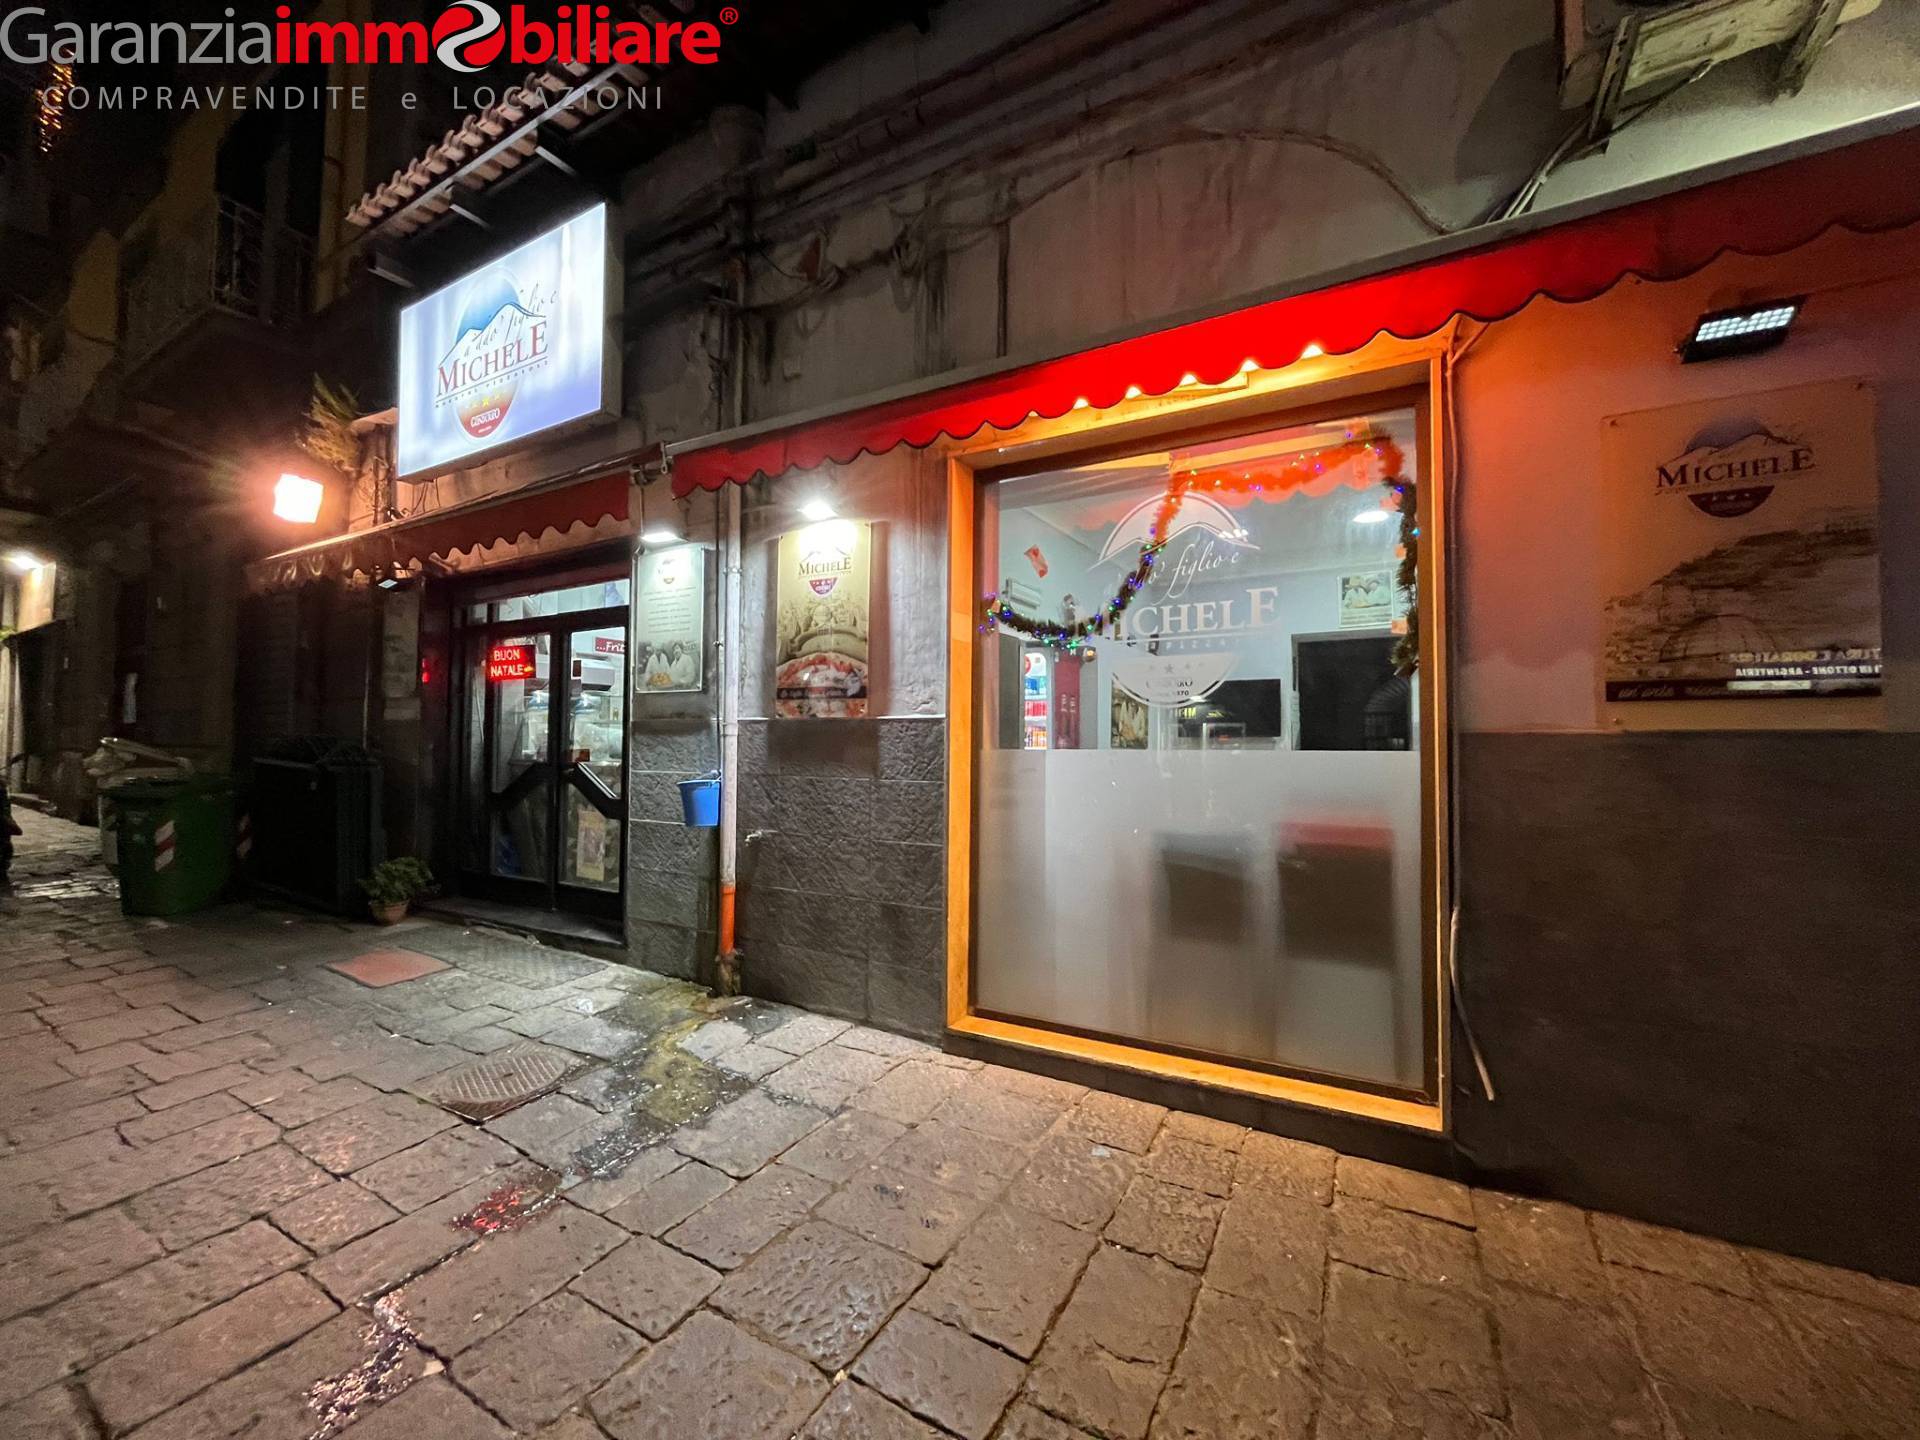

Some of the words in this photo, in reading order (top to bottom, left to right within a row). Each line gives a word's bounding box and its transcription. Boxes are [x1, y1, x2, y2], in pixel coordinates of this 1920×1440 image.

[436, 320, 549, 398] MICHELE
[1655, 447, 1817, 488] MICHELE
[798, 556, 852, 577] MICHELE
[493, 649, 521, 662] BUON
[490, 664, 525, 677] NATALE
